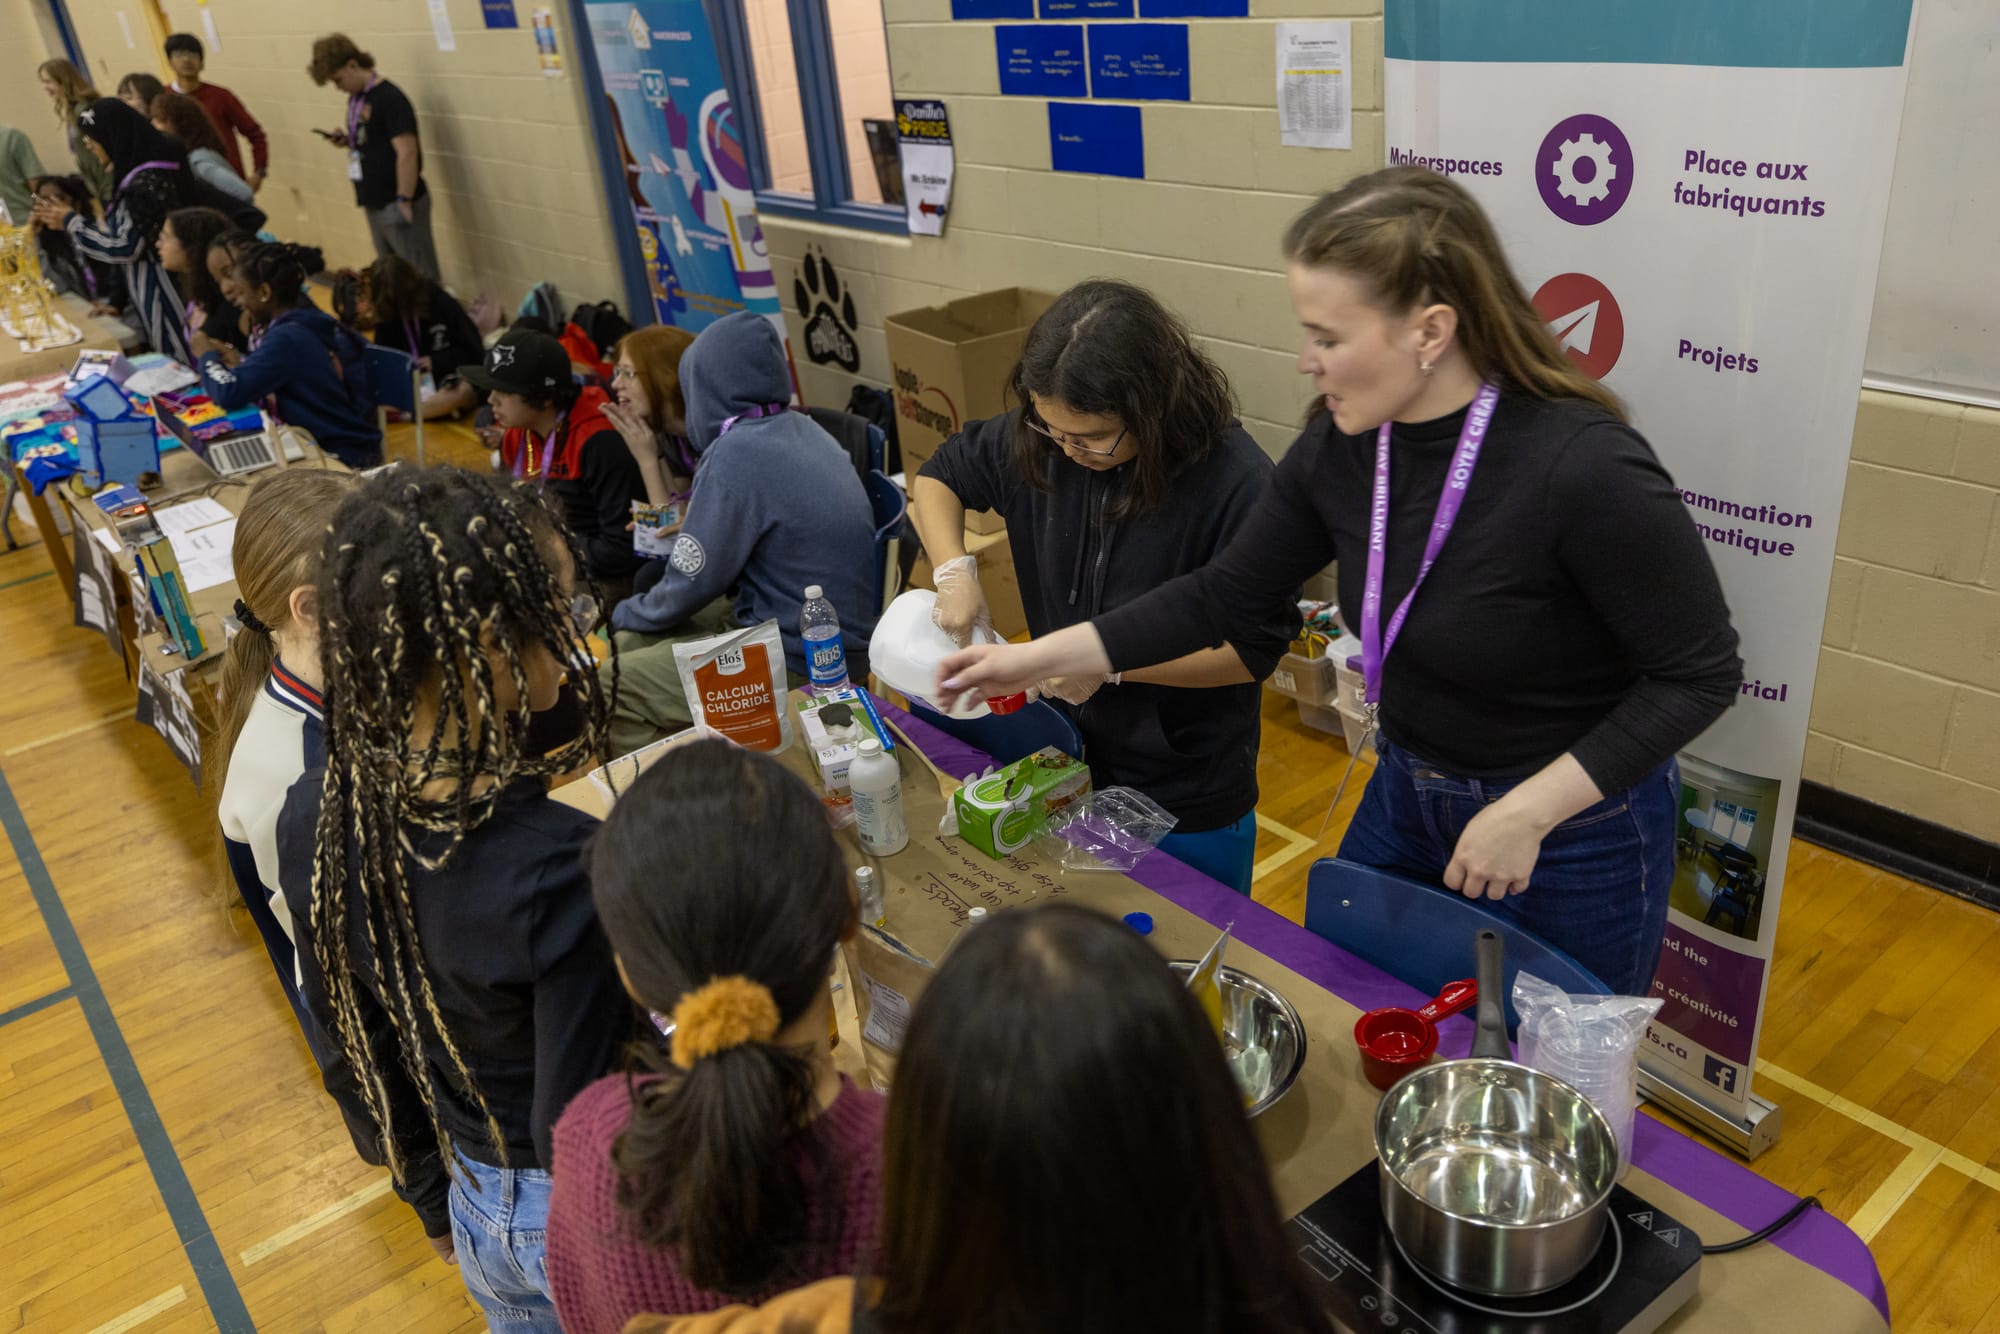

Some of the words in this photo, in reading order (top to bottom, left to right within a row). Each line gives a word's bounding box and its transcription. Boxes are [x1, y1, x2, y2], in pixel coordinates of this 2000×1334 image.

[1389, 147, 1504, 177] Makerspaces
[1684, 149, 1747, 177] Place
[1756, 160, 1808, 181] aux
[1674, 182, 1826, 218] fabriquants
[1678, 339, 1760, 374] Projets
[1376, 435, 1389, 471] STAY
[1451, 441, 1480, 491] SOYEZ
[1372, 475, 1388, 553] BRILLIANT
[706, 682, 765, 702] CALCIUM
[706, 694, 771, 713] CHLORIDE
[1738, 680, 1788, 702] rial
[1684, 947, 1709, 966] the
[1668, 987, 1739, 1028] créativité
